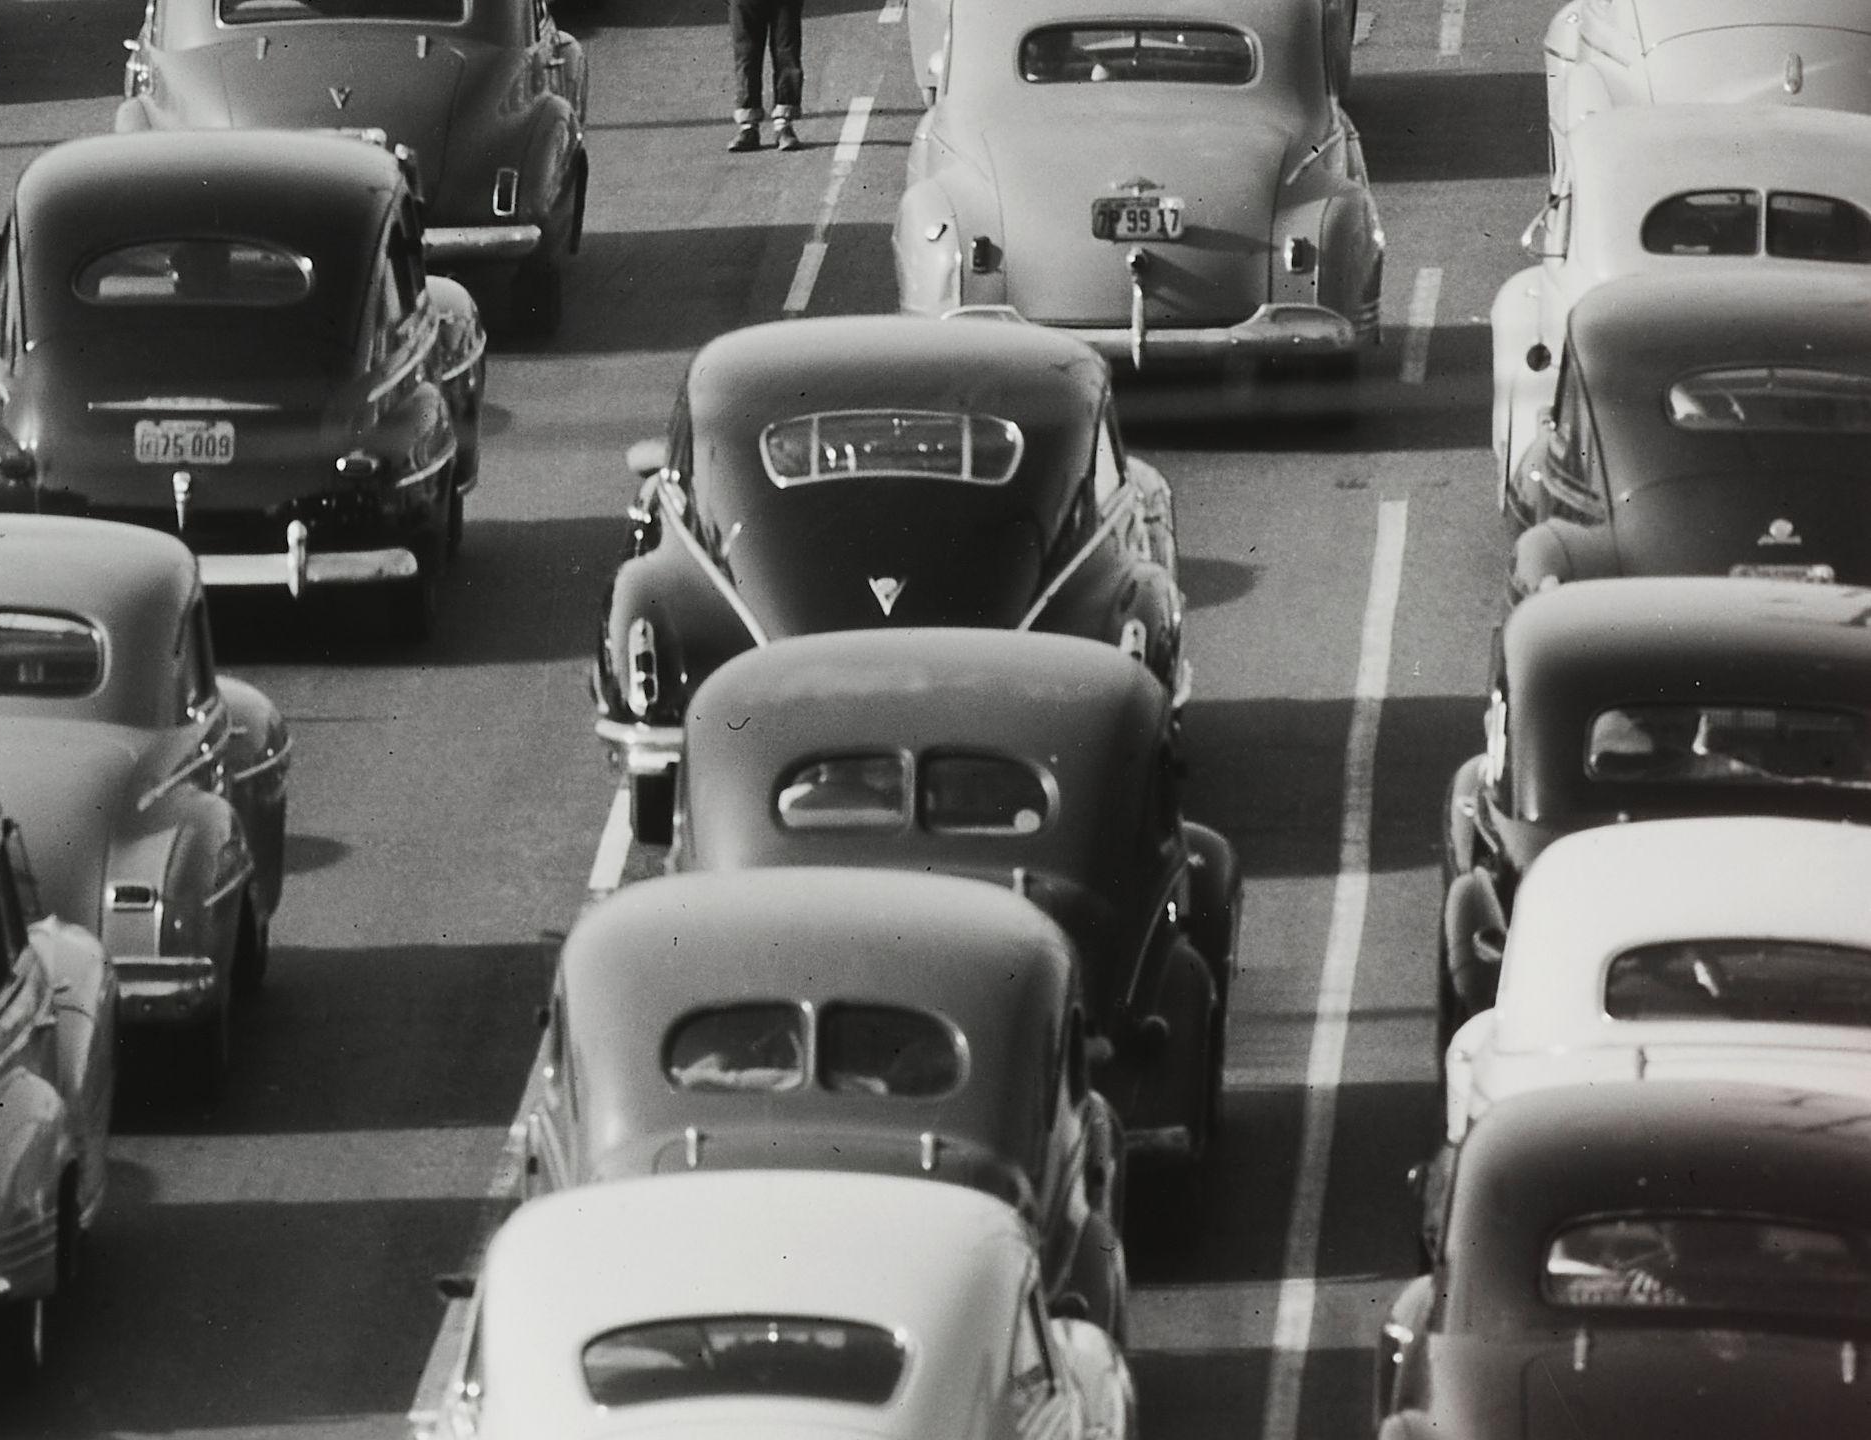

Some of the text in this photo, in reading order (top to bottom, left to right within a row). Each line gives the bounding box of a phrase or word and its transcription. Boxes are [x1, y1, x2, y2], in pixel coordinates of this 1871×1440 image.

[1126, 209, 1151, 234] 99
[1157, 208, 1180, 233] 17
[191, 434, 230, 457] 009
